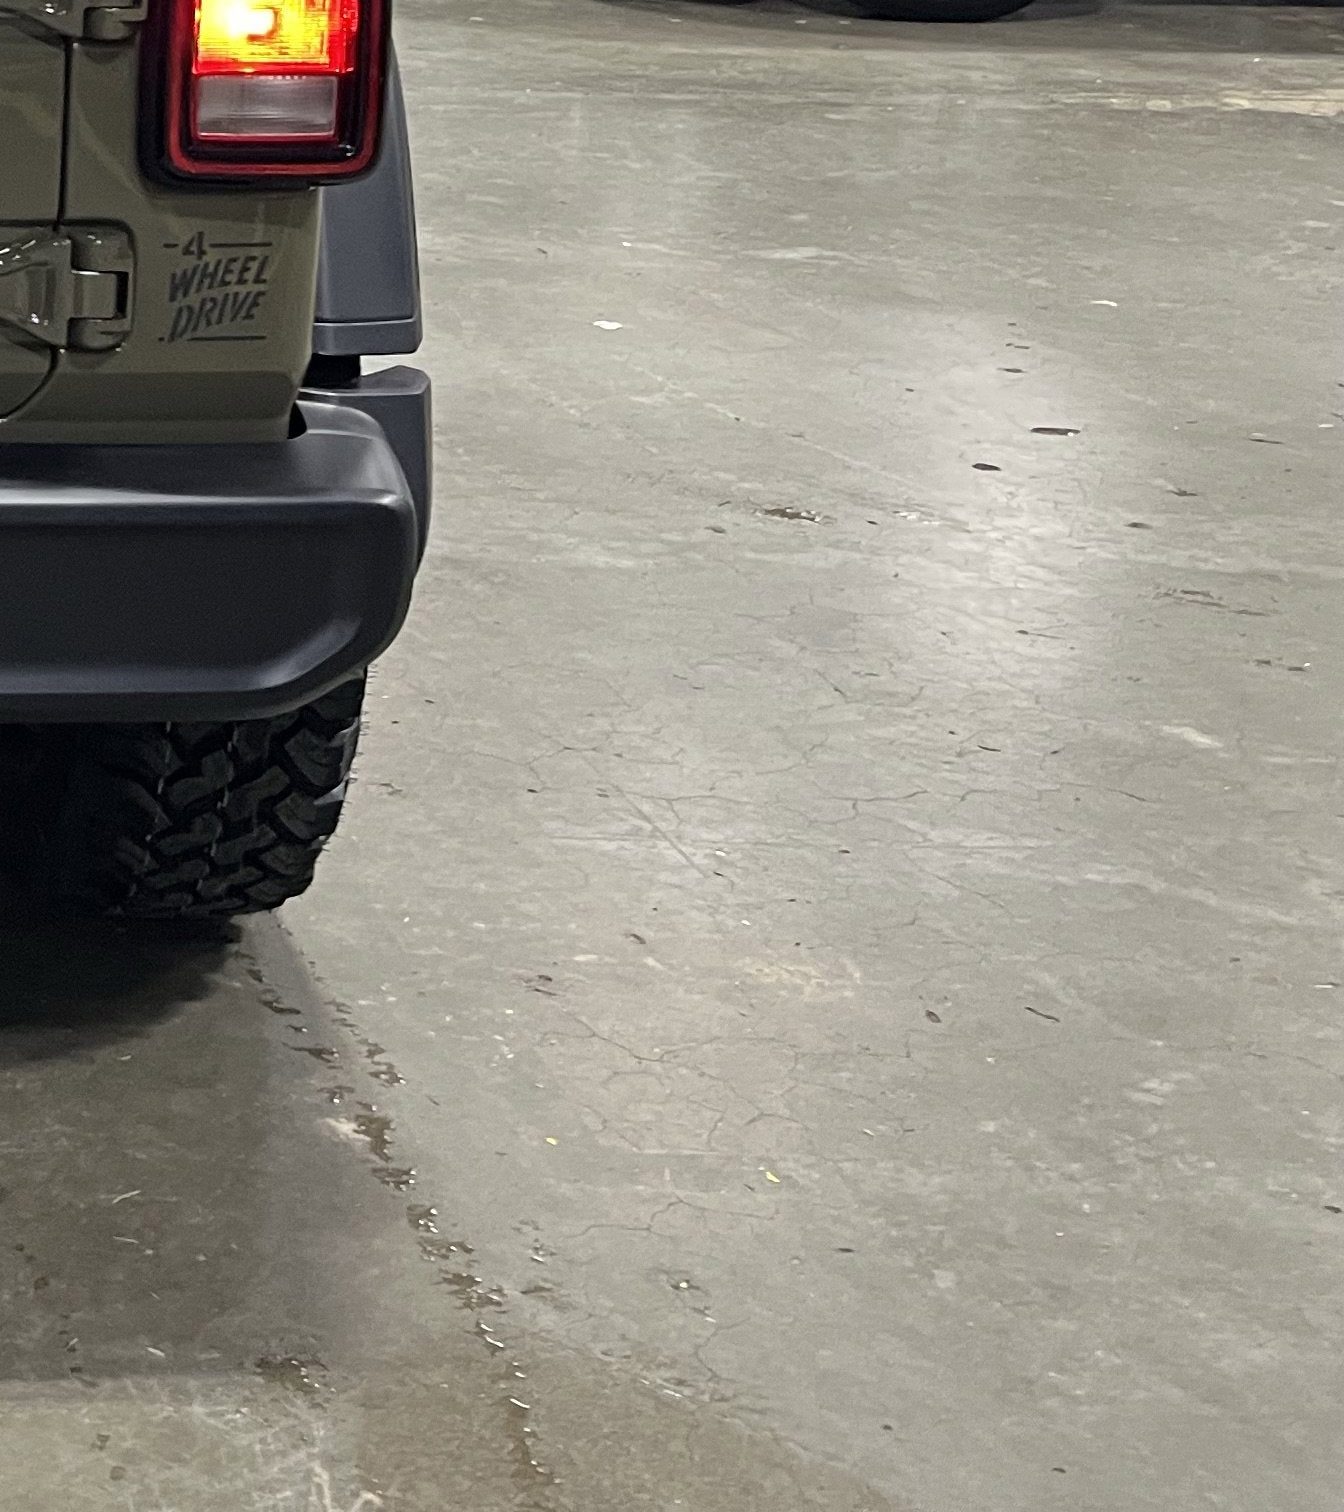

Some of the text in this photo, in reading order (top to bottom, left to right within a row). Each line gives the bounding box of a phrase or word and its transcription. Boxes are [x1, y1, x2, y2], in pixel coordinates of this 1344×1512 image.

[181, 231, 208, 260] 4
[168, 255, 270, 303] WHEEL
[167, 290, 266, 343] DRIVE
